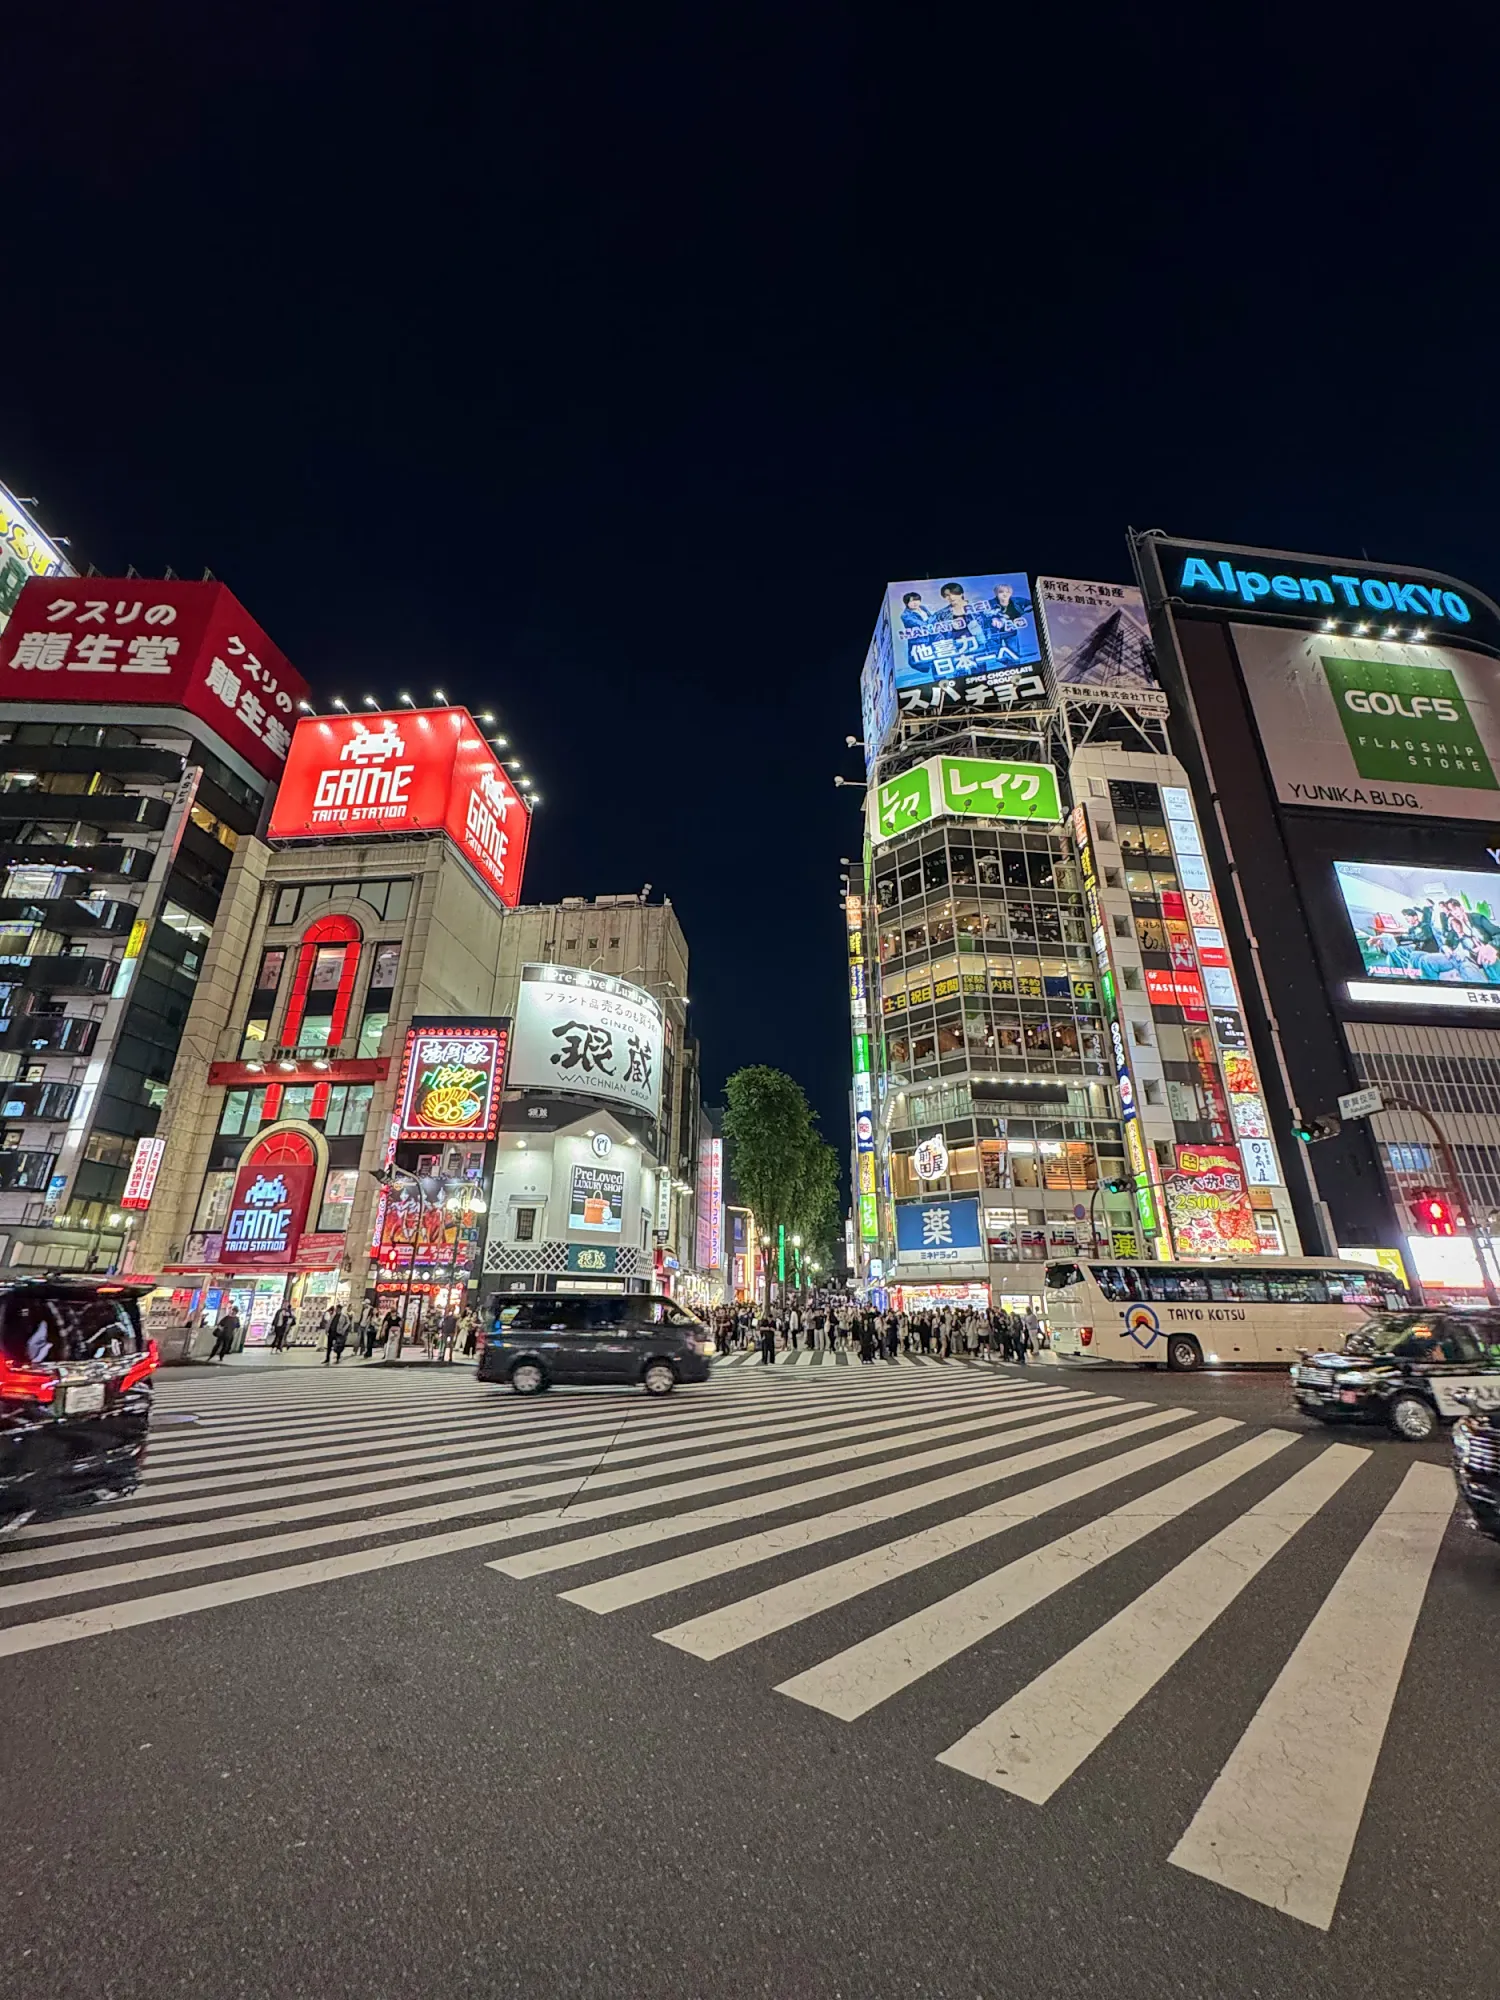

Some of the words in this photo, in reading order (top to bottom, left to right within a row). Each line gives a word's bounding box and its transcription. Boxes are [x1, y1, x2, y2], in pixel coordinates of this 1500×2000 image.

[47, 598, 177, 625] クスリの
[8, 632, 180, 674] 龍生堂
[910, 635, 979, 662] 他喜力
[934, 645, 1019, 675] 日本一へ
[227, 636, 293, 713] クスリの
[987, 666, 1033, 681] CHOCOLATE
[204, 657, 291, 759] 龍生堂
[1345, 689, 1459, 722] GOLF5
[1358, 735, 1475, 757] FLAGSHIP
[1408, 755, 1482, 772] STORE
[314, 765, 414, 807] GAME
[949, 769, 1040, 800] レイク
[1288, 782, 1367, 804] YUNIKA
[312, 808, 348, 822] TAITO
[351, 804, 407, 820] STATION
[911, 986, 932, 1005] 祝日
[936, 975, 960, 996] 夜間
[991, 980, 1013, 992] 内科
[1075, 983, 1094, 997] 6F
[601, 1018, 634, 1034] GINZO
[550, 1021, 652, 1095] 銀蔵
[557, 1072, 627, 1093] WATCHNIAN
[631, 1088, 649, 1101] GROUP
[574, 1167, 623, 1184] PreLoved
[574, 1179, 603, 1190] LUXURY
[603, 1182, 622, 1193] SHOP
[227, 1209, 292, 1239] GAME
[921, 1207, 953, 1245] 薬
[225, 1240, 248, 1251] TAITO
[249, 1240, 285, 1251] STATION
[920, 1250, 958, 1260] ミネドラッグ
[1113, 1233, 1138, 1257] 薬
[1168, 1308, 1204, 1321] TAIYO
[1208, 1308, 1246, 1321] KOTSU
